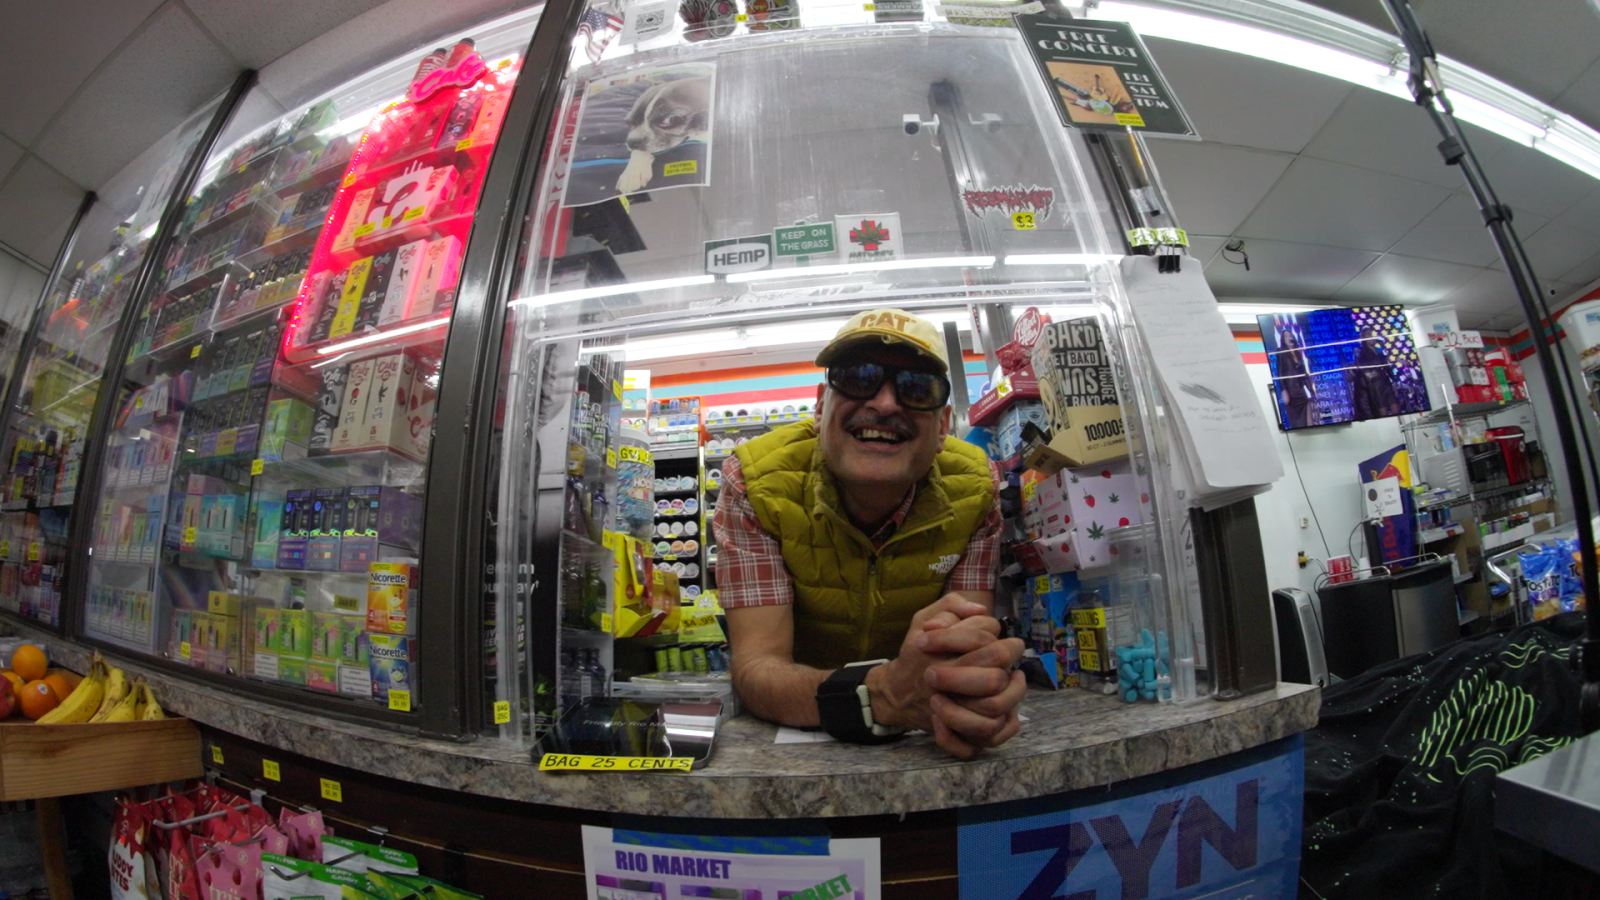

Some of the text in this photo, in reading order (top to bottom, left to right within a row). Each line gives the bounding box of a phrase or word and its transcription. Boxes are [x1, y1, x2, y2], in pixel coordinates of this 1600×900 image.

[1058, 30, 1110, 44] FREE
[1038, 39, 1138, 58] CONCERT
[1123, 72, 1150, 83] FRI
[1129, 84, 1157, 96] SAT
[1016, 214, 1034, 228] $3
[781, 228, 827, 241] KEEP ON
[780, 238, 830, 251] THE GRASS
[714, 248, 766, 267] HEMP
[860, 312, 909, 332] CAT
[1046, 324, 1096, 349] BAK'D
[378, 356, 398, 372] Cake
[1070, 351, 1096, 364] BAK'D
[370, 572, 406, 584] Nicorette
[682, 614, 715, 628] $4.99
[1079, 634, 1094, 648] SALT
[370, 645, 407, 659] Nicorette
[496, 704, 508, 712] BAG
[545, 755, 690, 769] BAG 25 CENTS
[1010, 778, 1259, 900] ZYN
[616, 850, 731, 880] RIO MARKET
